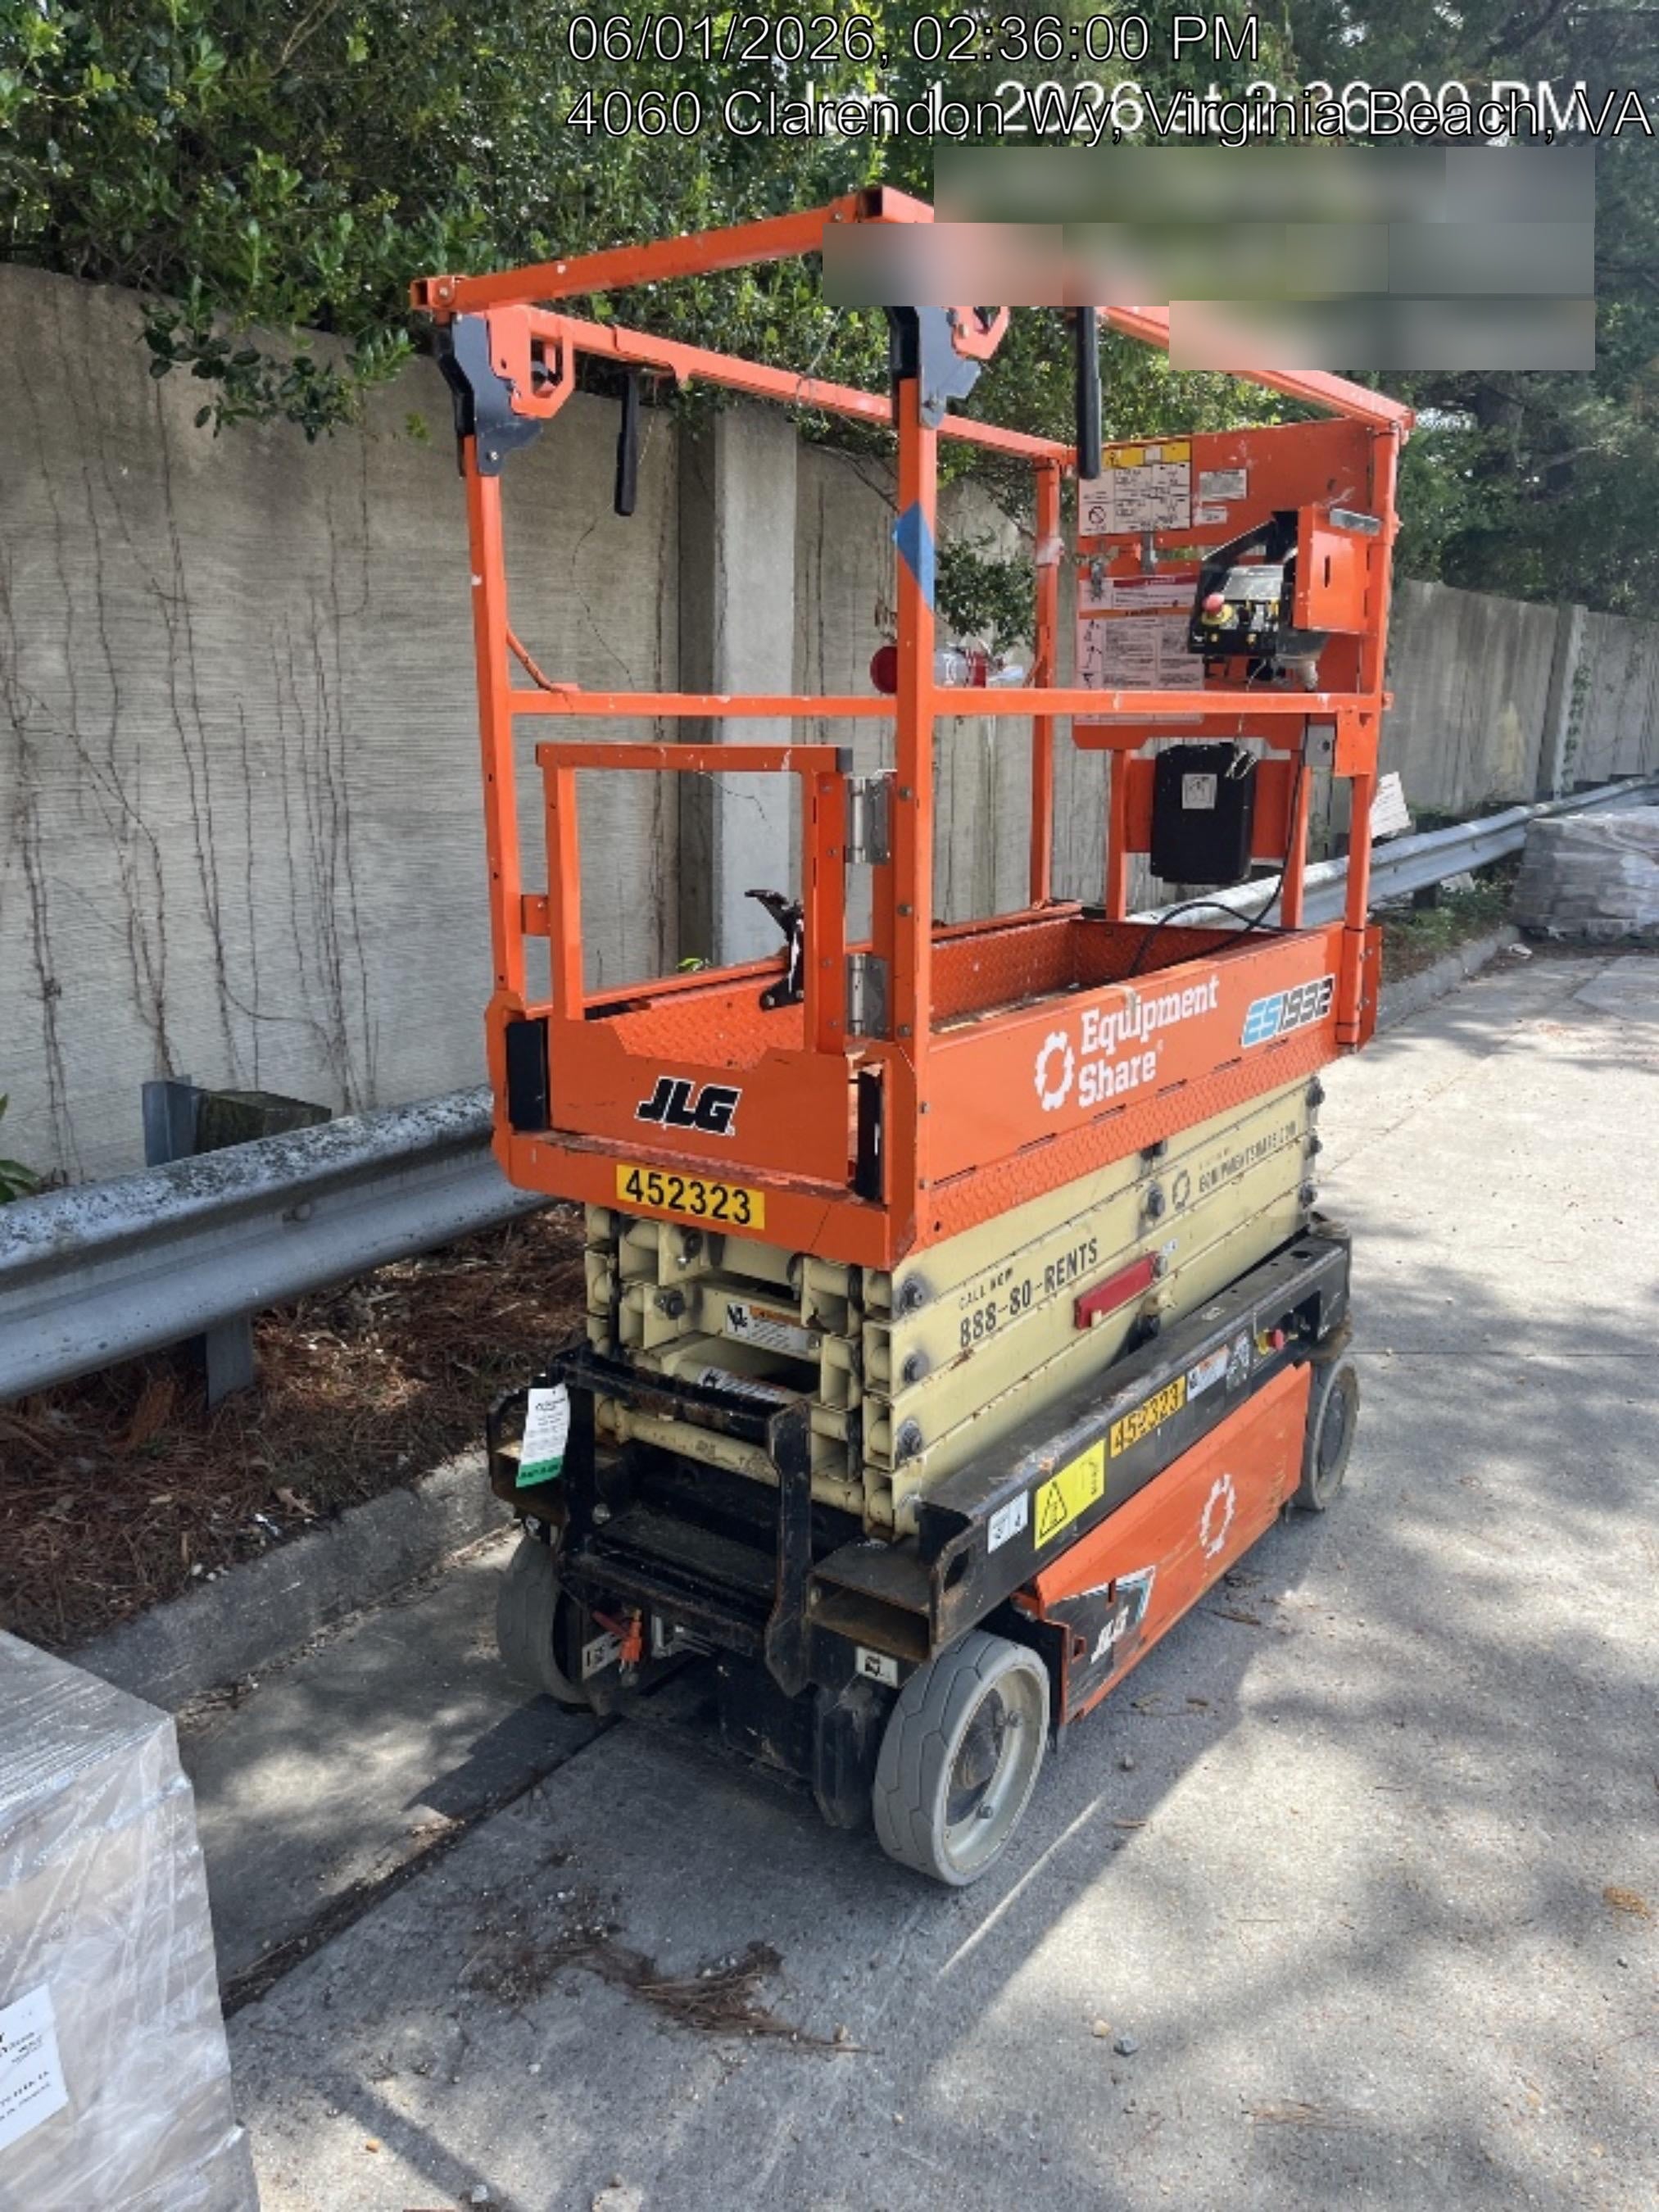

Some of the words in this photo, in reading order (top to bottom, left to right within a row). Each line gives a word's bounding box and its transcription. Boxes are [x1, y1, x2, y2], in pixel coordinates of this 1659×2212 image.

[1081, 974, 1220, 1056] Equipment
[634, 1075, 743, 1137] JLG
[1077, 1049, 1158, 1109] Share
[625, 1168, 750, 1225] 452323
[959, 1236, 1099, 1351] 888-80-RENTS
